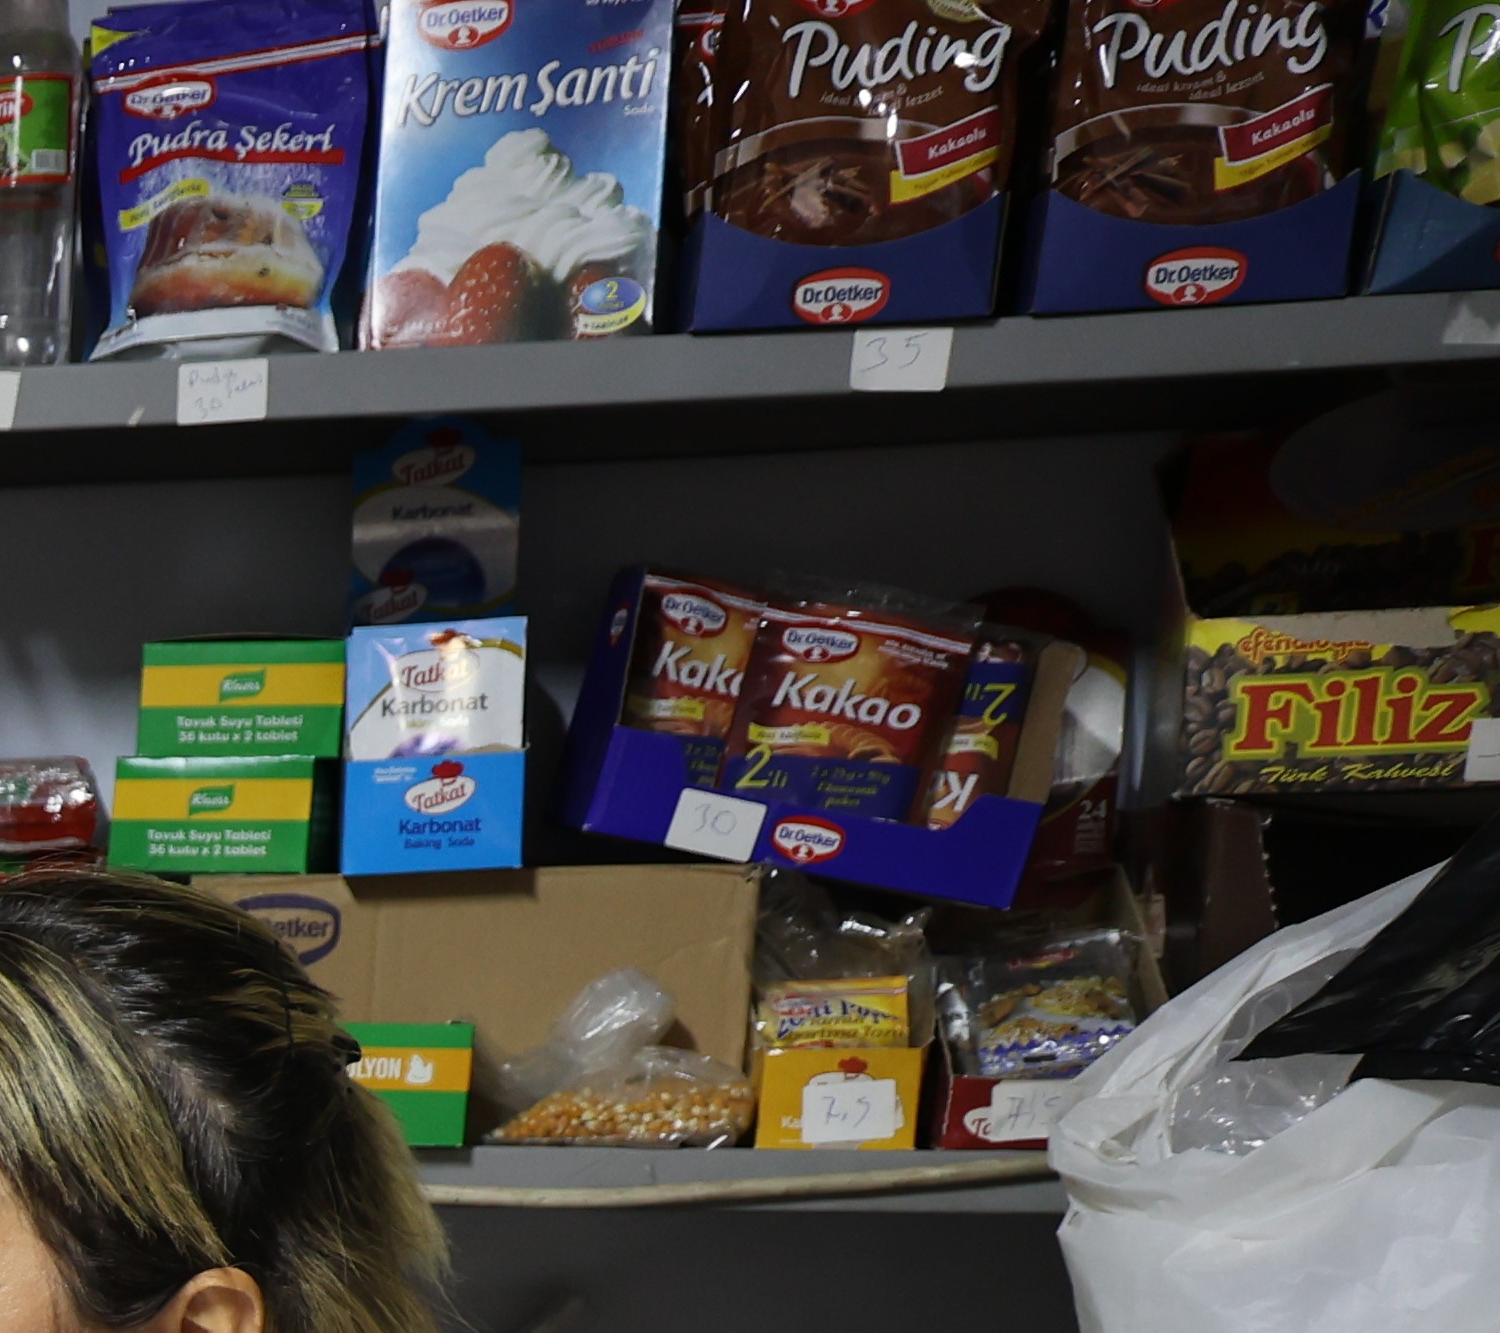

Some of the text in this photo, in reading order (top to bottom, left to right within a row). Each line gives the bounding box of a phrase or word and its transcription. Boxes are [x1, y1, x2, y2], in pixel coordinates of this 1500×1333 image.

[783, 21, 1011, 97] Puding
[1094, 0, 1328, 89] Puding
[395, 48, 662, 127] Krem Şanti
[927, 127, 988, 160] Kakaolu
[1251, 107, 1316, 145] Kakaolu
[129, 121, 334, 168] Pudra Şekeri
[1154, 261, 1239, 285] Dr.Oetker
[801, 282, 884, 306] Dr.Oetker
[382, 691, 488, 719] Karbonat
[772, 672, 923, 731] Kakao
[1233, 674, 1479, 753] Filiz
[1259, 761, 1455, 785] Türk Kahvesi
[409, 781, 469, 809] Tatkat
[398, 815, 482, 835] Karbonat
